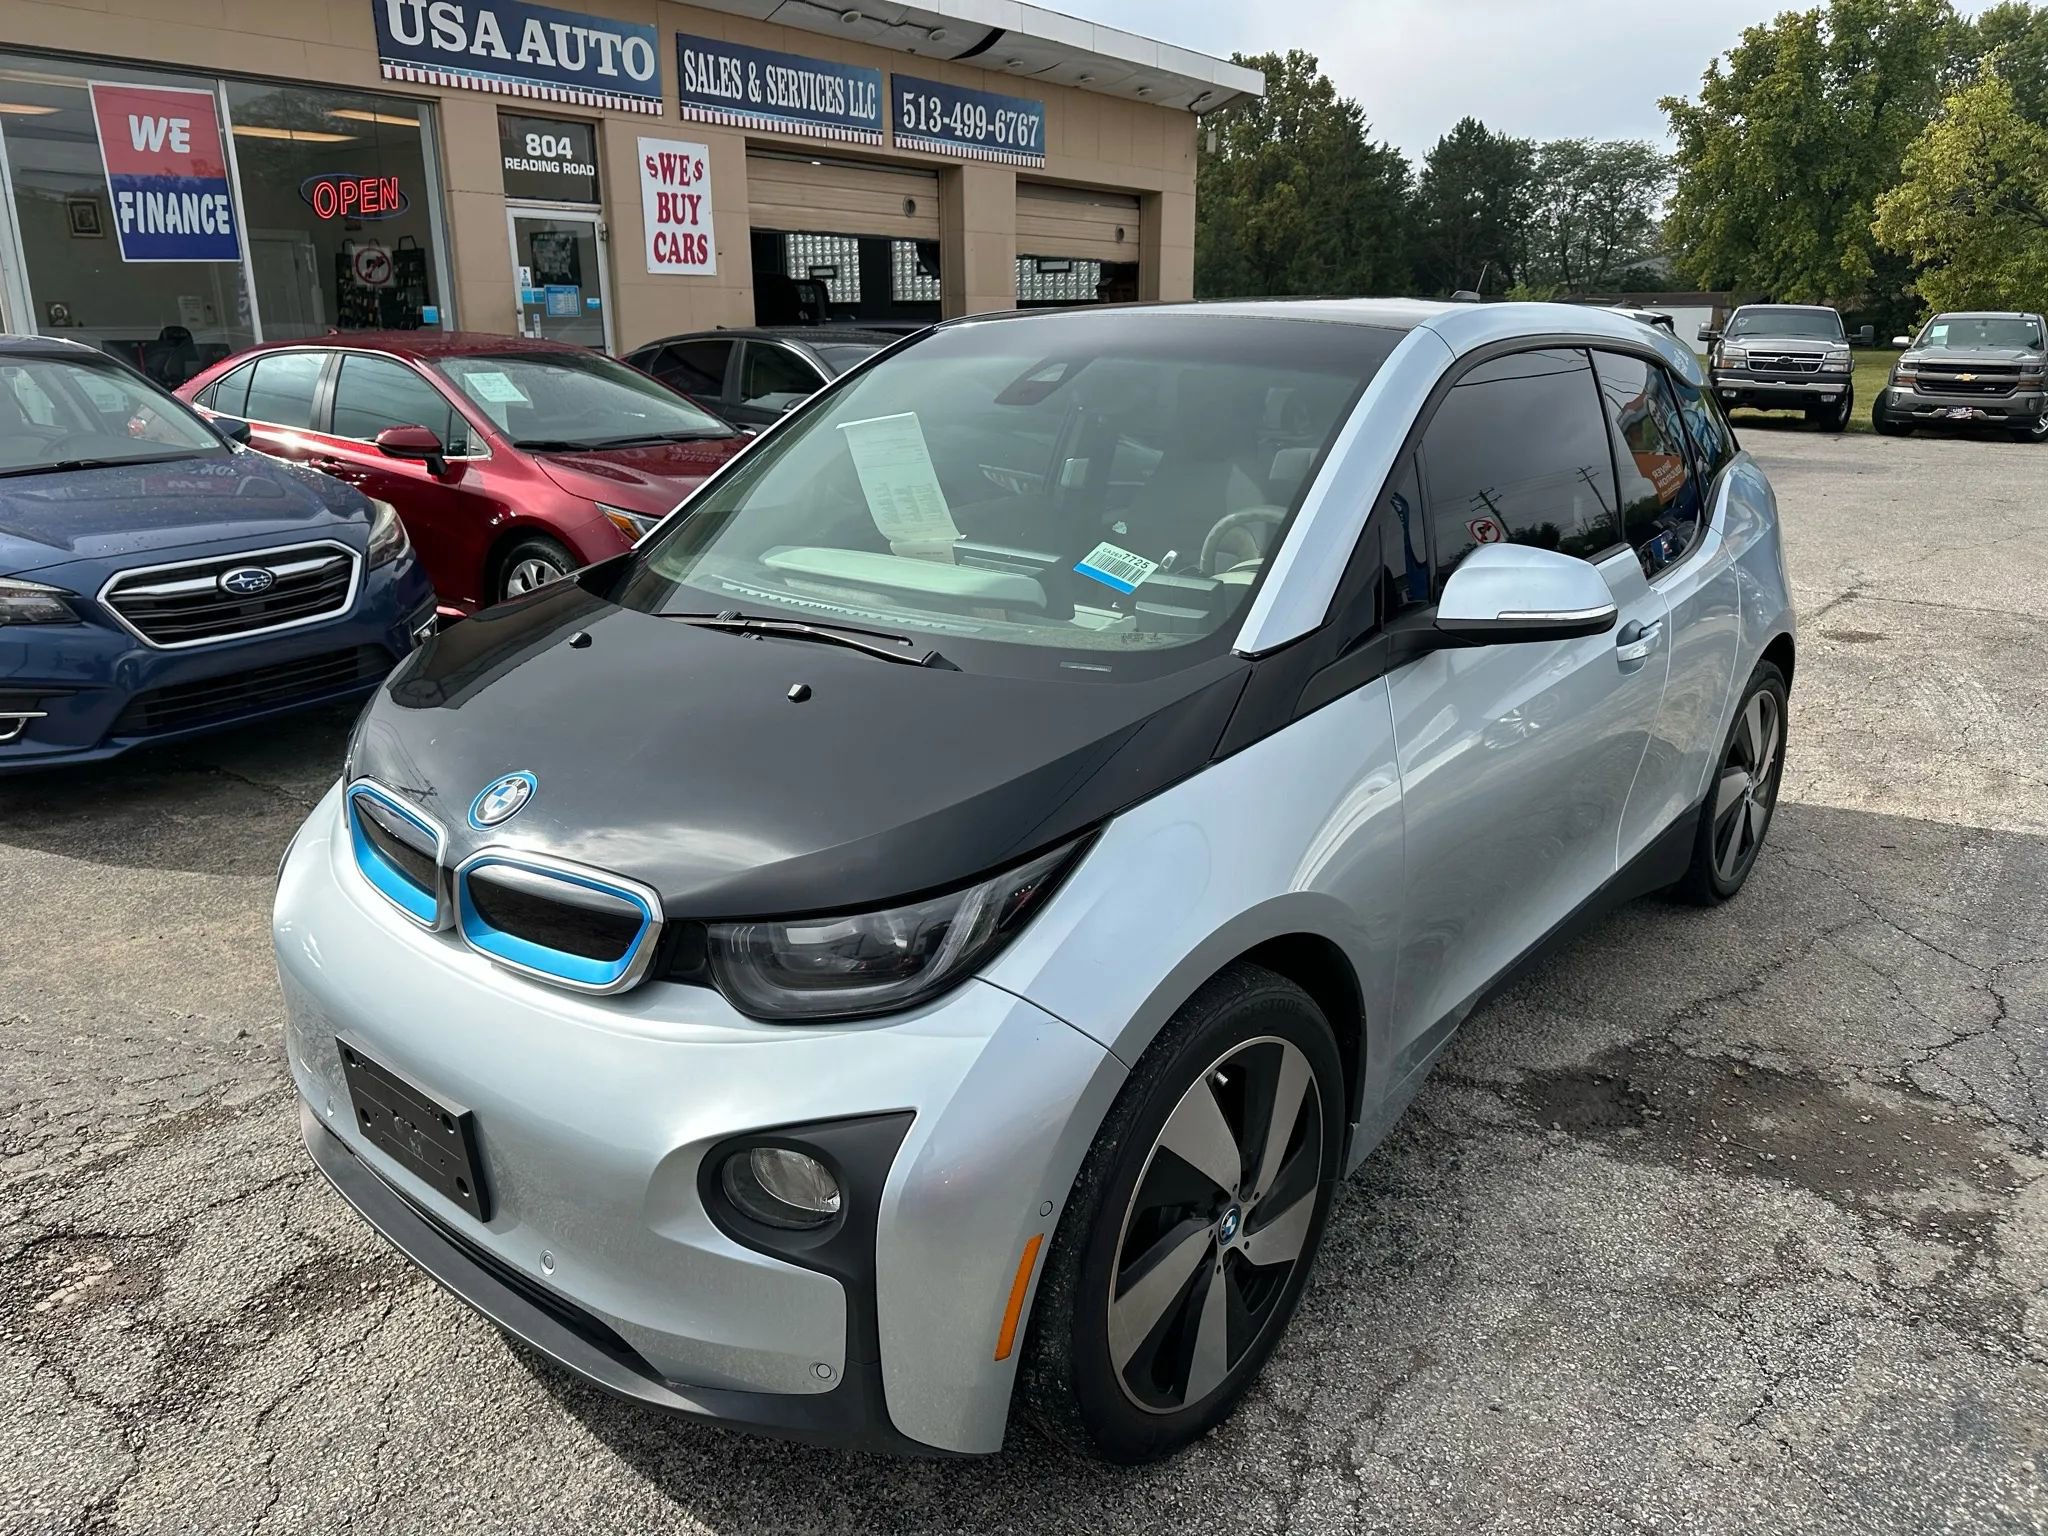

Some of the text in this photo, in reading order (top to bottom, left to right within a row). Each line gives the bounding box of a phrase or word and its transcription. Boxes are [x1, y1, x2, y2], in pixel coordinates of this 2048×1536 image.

[387, 0, 655, 82] USA AUTO
[684, 49, 876, 120] SALES & SERVICES LLC
[128, 114, 190, 153] WE
[903, 91, 1040, 147] 513-499-6767
[504, 157, 595, 176] READING ROAD
[525, 133, 573, 159] 804
[118, 191, 230, 235] FINANCE
[313, 176, 399, 219] OPEN
[657, 192, 702, 225] BUY
[653, 231, 708, 265] CARS
